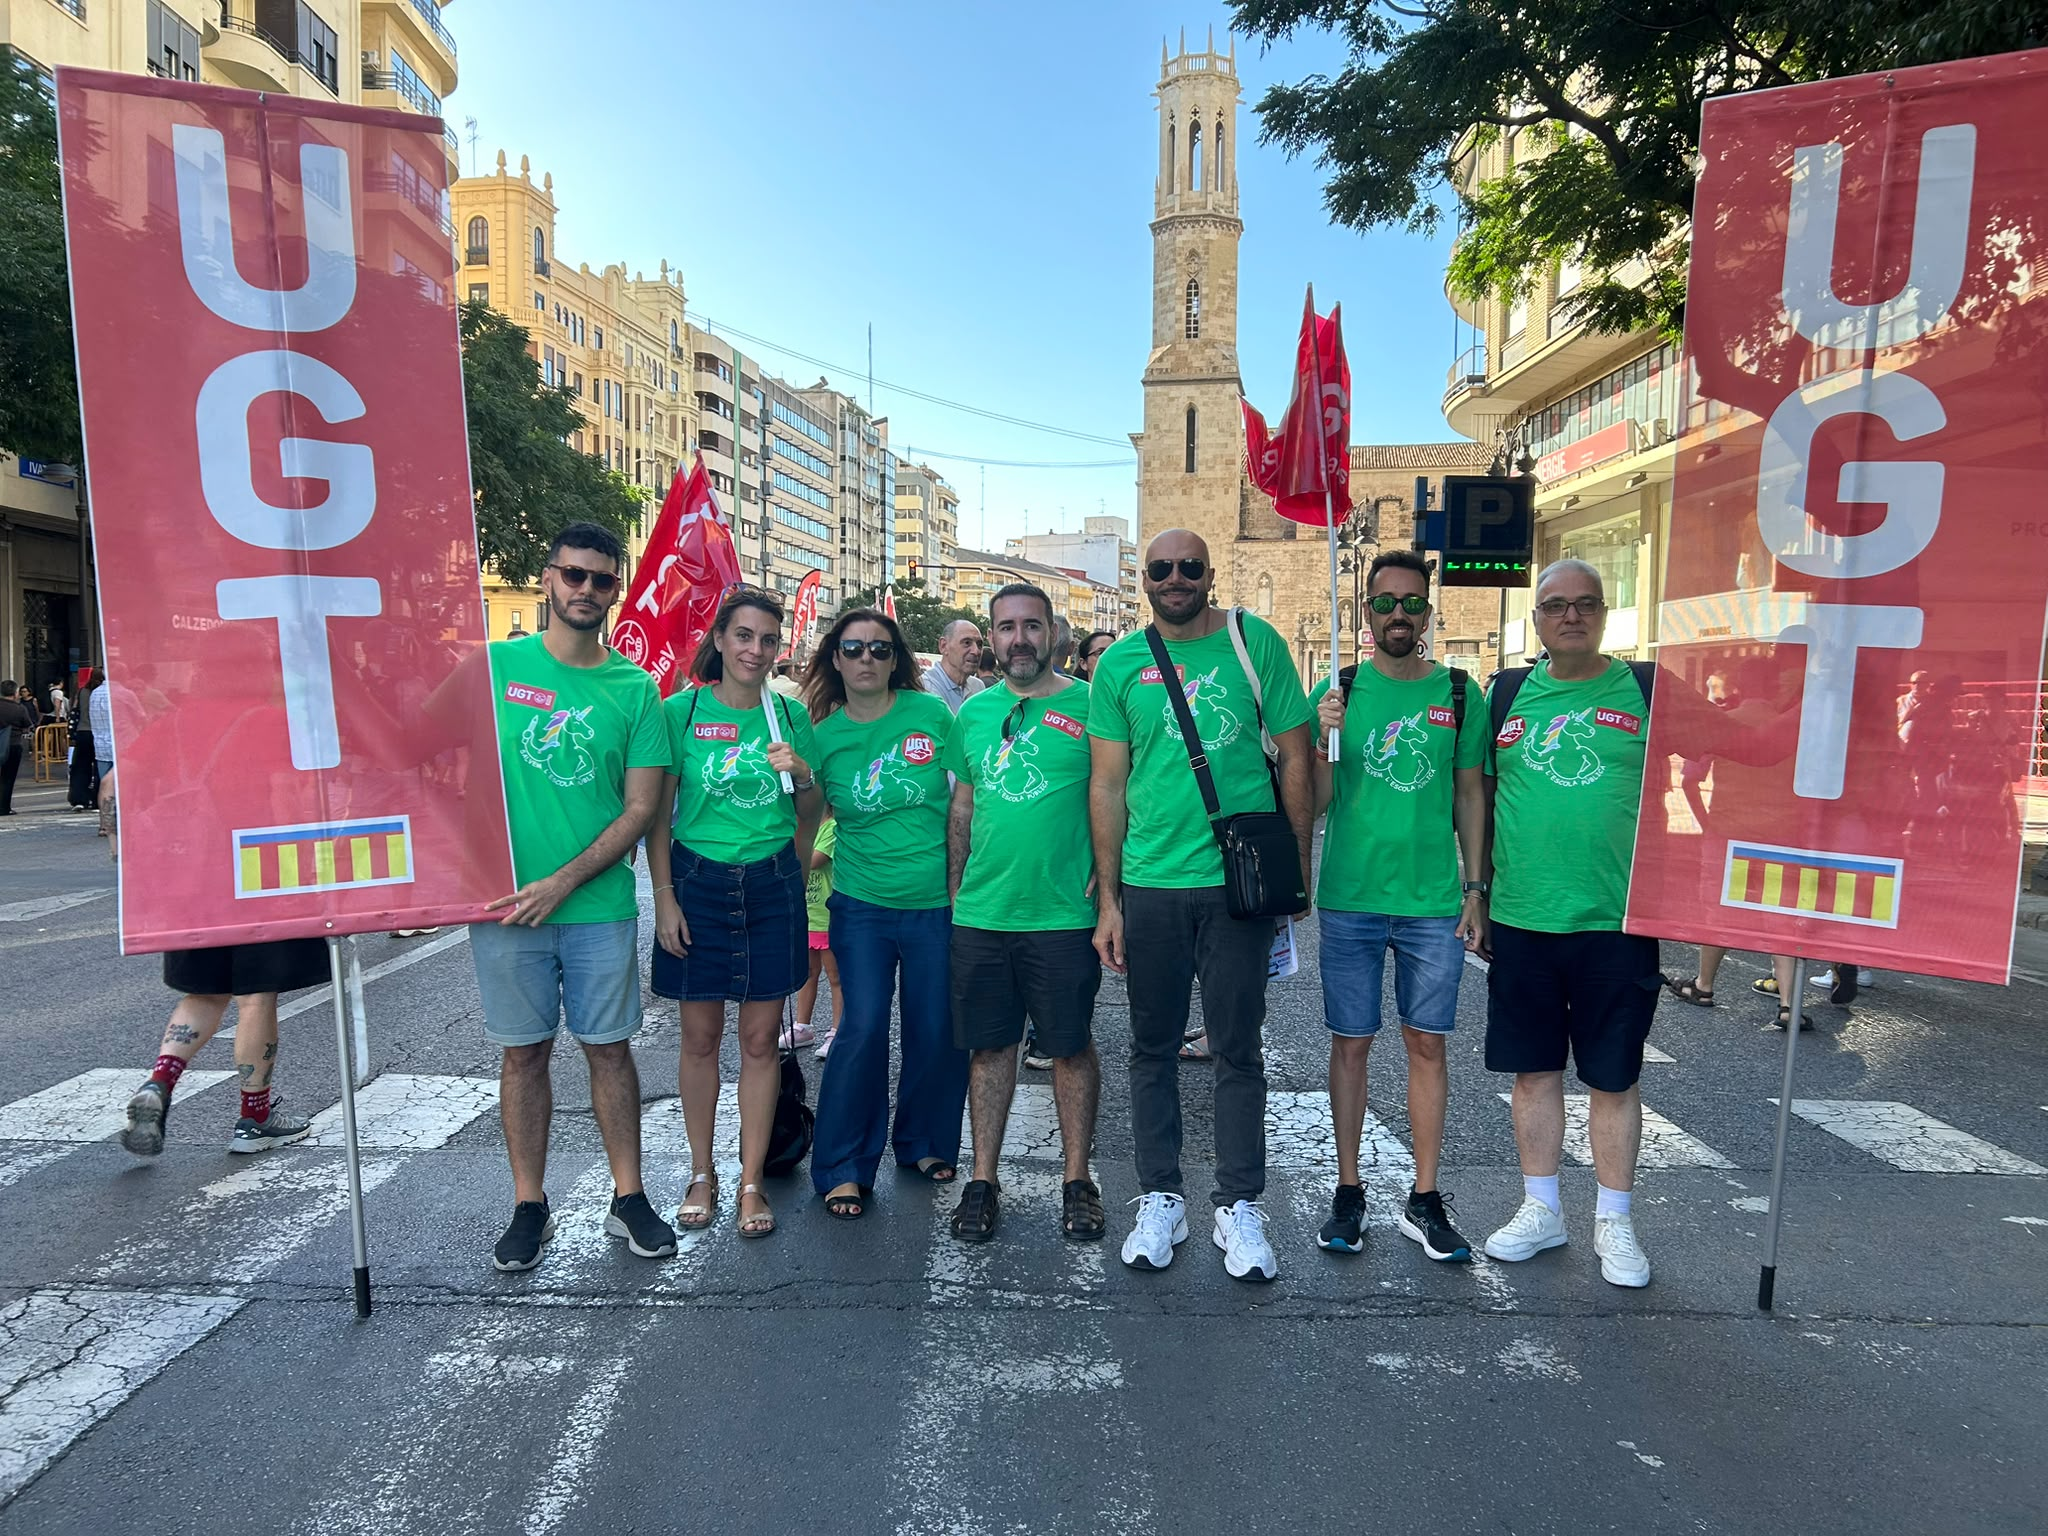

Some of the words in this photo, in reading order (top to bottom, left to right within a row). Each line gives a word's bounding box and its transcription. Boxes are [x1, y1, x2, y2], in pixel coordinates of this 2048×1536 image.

[172, 124, 382, 770] UGT
[1756, 123, 1977, 800] UGT
[1464, 487, 1514, 546] P
[1417, 644, 1425, 655] 0
[507, 686, 535, 701] UGT
[1044, 713, 1068, 727] UGT
[1429, 710, 1452, 722] UGT
[1597, 711, 1623, 724] UGT
[695, 727, 719, 737] UGT
[1163, 725, 1184, 741] SALVE
[1502, 718, 1523, 734] UGT
[906, 738, 930, 751] UGT
[1363, 761, 1383, 777] SALVEM
[1385, 776, 1416, 792] L'ESCOLA
[1520, 753, 1544, 771] SALVEM
[1545, 770, 1578, 787] L'ESCOLA
[726, 793, 757, 808] L'ESCOLA
[997, 789, 1025, 803] L'ESCOLA
